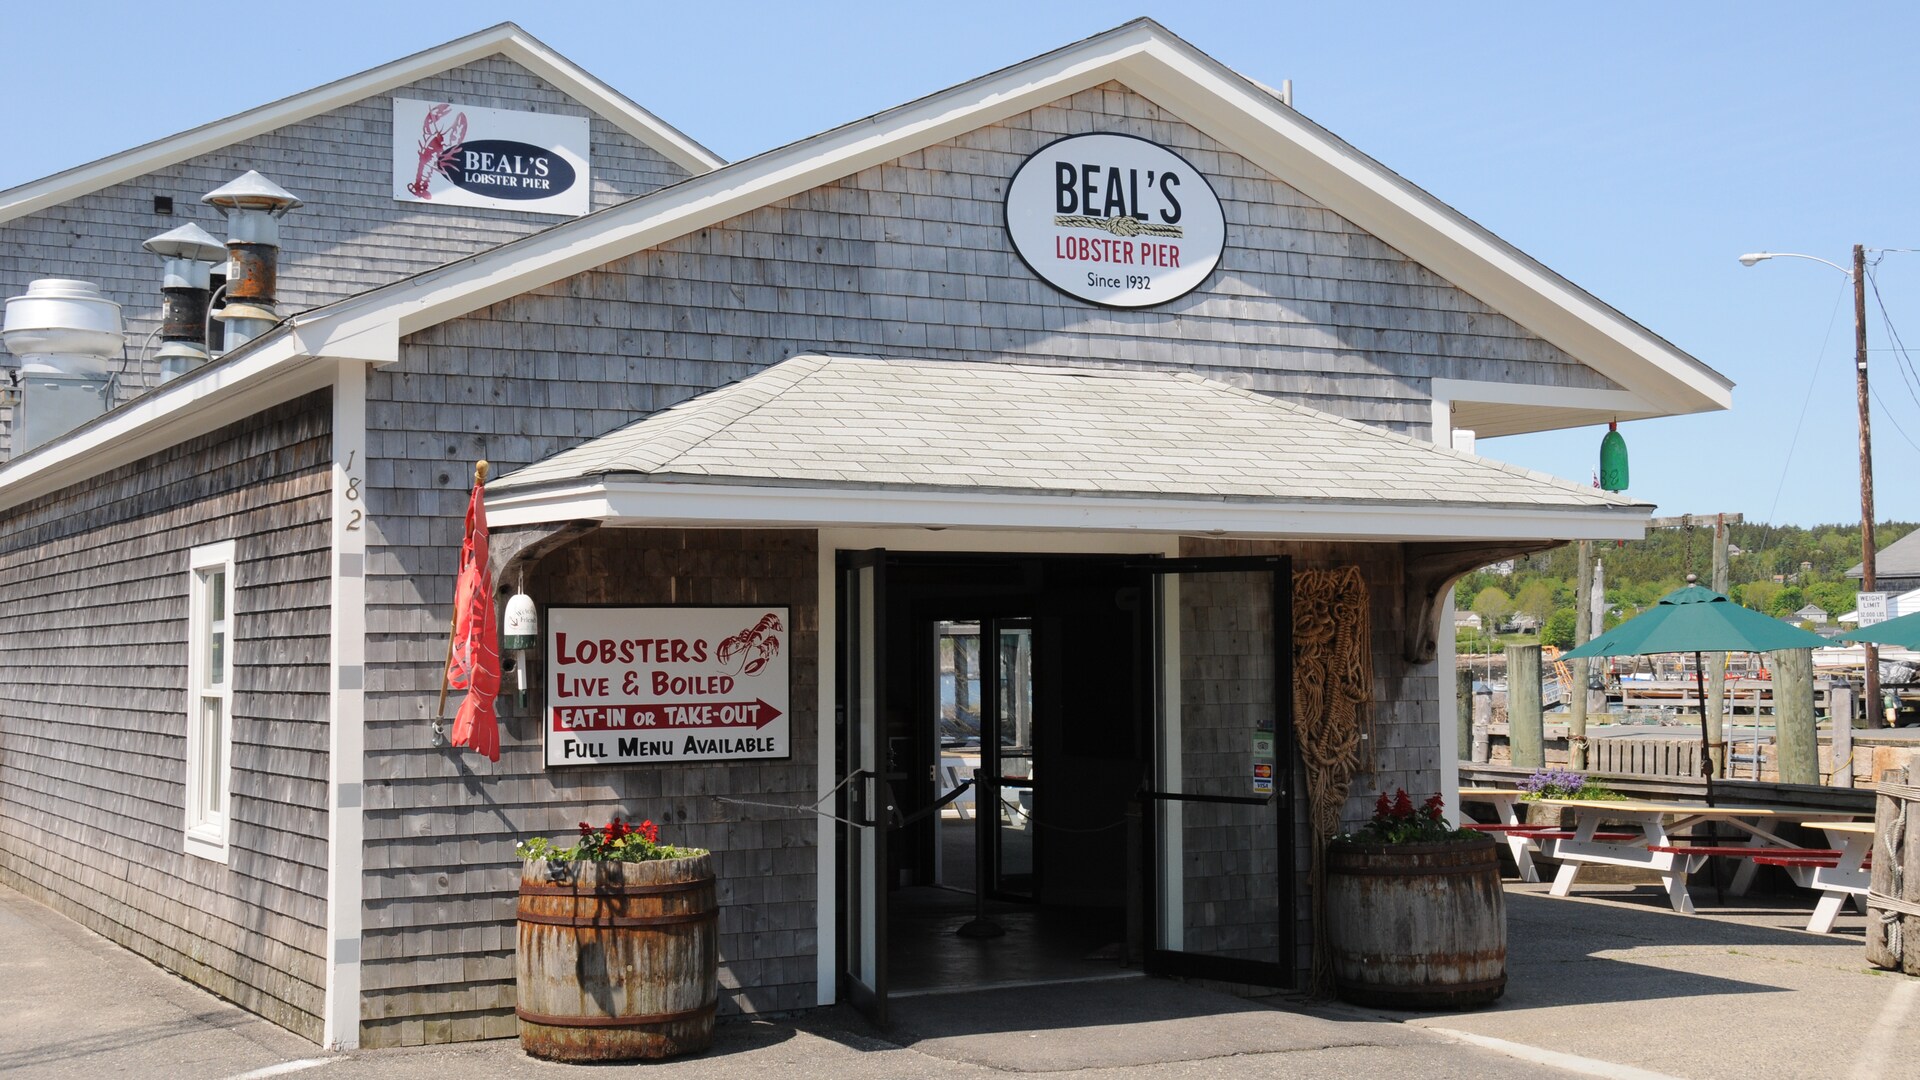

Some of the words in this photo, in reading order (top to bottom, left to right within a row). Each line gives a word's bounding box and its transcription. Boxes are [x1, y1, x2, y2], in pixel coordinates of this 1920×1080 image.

[464, 150, 549, 176] BEAL'S
[465, 172, 518, 187] LOBSTER
[522, 177, 550, 190] PIER
[1056, 161, 1182, 224] BEAL'S
[1056, 235, 1134, 265] LOBSTER
[1141, 243, 1181, 268] PIER
[1087, 272, 1121, 288] Since
[1126, 275, 1151, 290] 1932
[555, 632, 708, 665] LOBSTERS
[556, 673, 610, 698] LIVE
[622, 670, 640, 696] &
[651, 671, 735, 696] BOILED
[561, 708, 626, 729] EAT-IN
[633, 711, 657, 726] OR
[664, 704, 761, 726] TAKE-OUT
[564, 739, 608, 759] FULL
[618, 737, 674, 757] MENU
[683, 735, 775, 755] AVAILABLE
